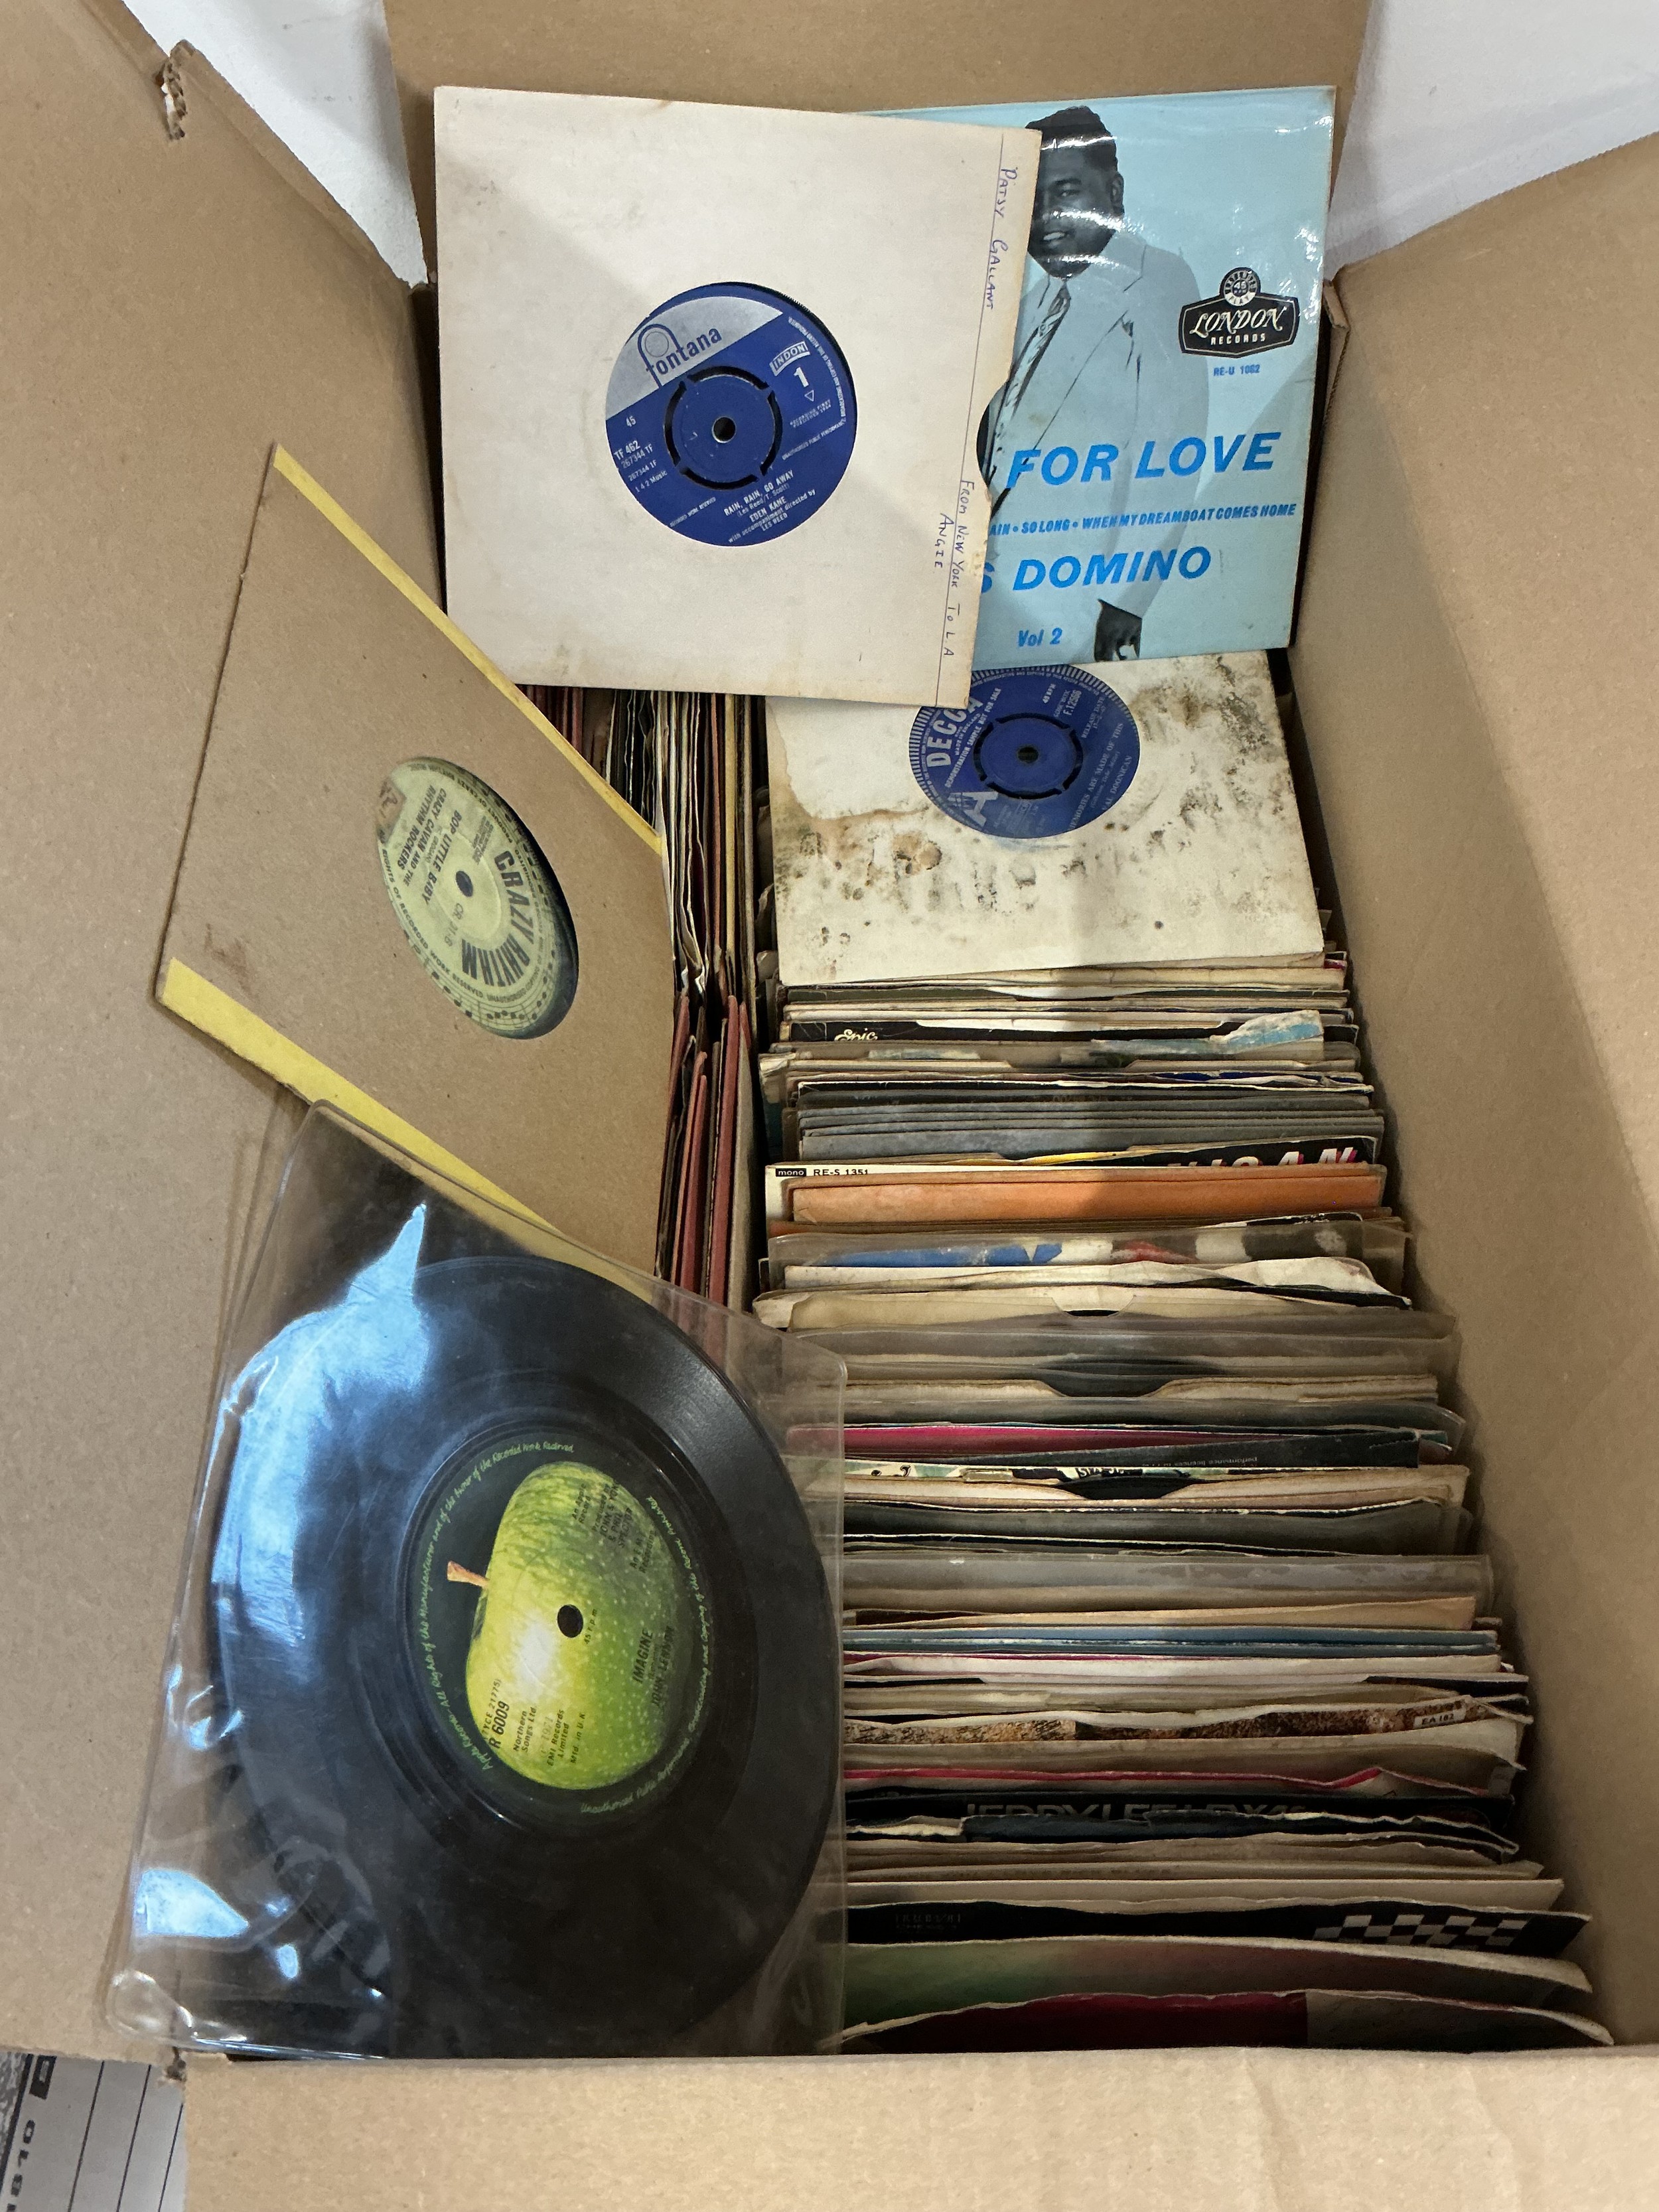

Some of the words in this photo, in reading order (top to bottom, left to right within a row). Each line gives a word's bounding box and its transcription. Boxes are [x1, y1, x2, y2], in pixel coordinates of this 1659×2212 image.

[987, 239, 1009, 310] GALLANT
[1189, 306, 1287, 338] LONDON
[1210, 333, 1265, 345] RECORDS
[638, 324, 722, 389] fontana
[794, 366, 810, 388] 1
[626, 415, 636, 427] 45
[614, 449, 624, 460] TF
[625, 440, 640, 454] 462
[1006, 443, 1119, 489] FOR
[1135, 431, 1281, 480] LOVE
[724, 502, 743, 516] RAIN,
[764, 482, 774, 492] GO
[776, 470, 794, 485] AWAY
[749, 507, 767, 522] EDEN
[768, 496, 787, 511] KANE
[1082, 515, 1118, 530] WHEN
[1139, 508, 1214, 526] DREAMBOAT
[1215, 505, 1258, 520] COMES
[1261, 503, 1297, 518] HOME
[934, 512, 954, 569] ANGIE
[1013, 546, 1211, 591] DOMINO
[1017, 628, 1043, 647] Vol
[1049, 628, 1062, 645] 2
[415, 785, 436, 828] RHYTHM
[431, 788, 447, 820] CRAZY
[448, 809, 463, 834] BOP
[397, 826, 419, 870] ROCKERS
[419, 820, 436, 852] CAVAN
[438, 831, 453, 872] LITTLE
[404, 867, 415, 887] THE
[412, 850, 423, 868] AND
[423, 868, 440, 905] BABY
[494, 850, 534, 944] CRAZY
[632, 1628, 654, 1684] IMAGINE
[492, 1700, 510, 1736] 6009
[513, 1710, 528, 1753] Northern
[551, 1708, 565, 1747] Records
[488, 1737, 501, 1749] R
